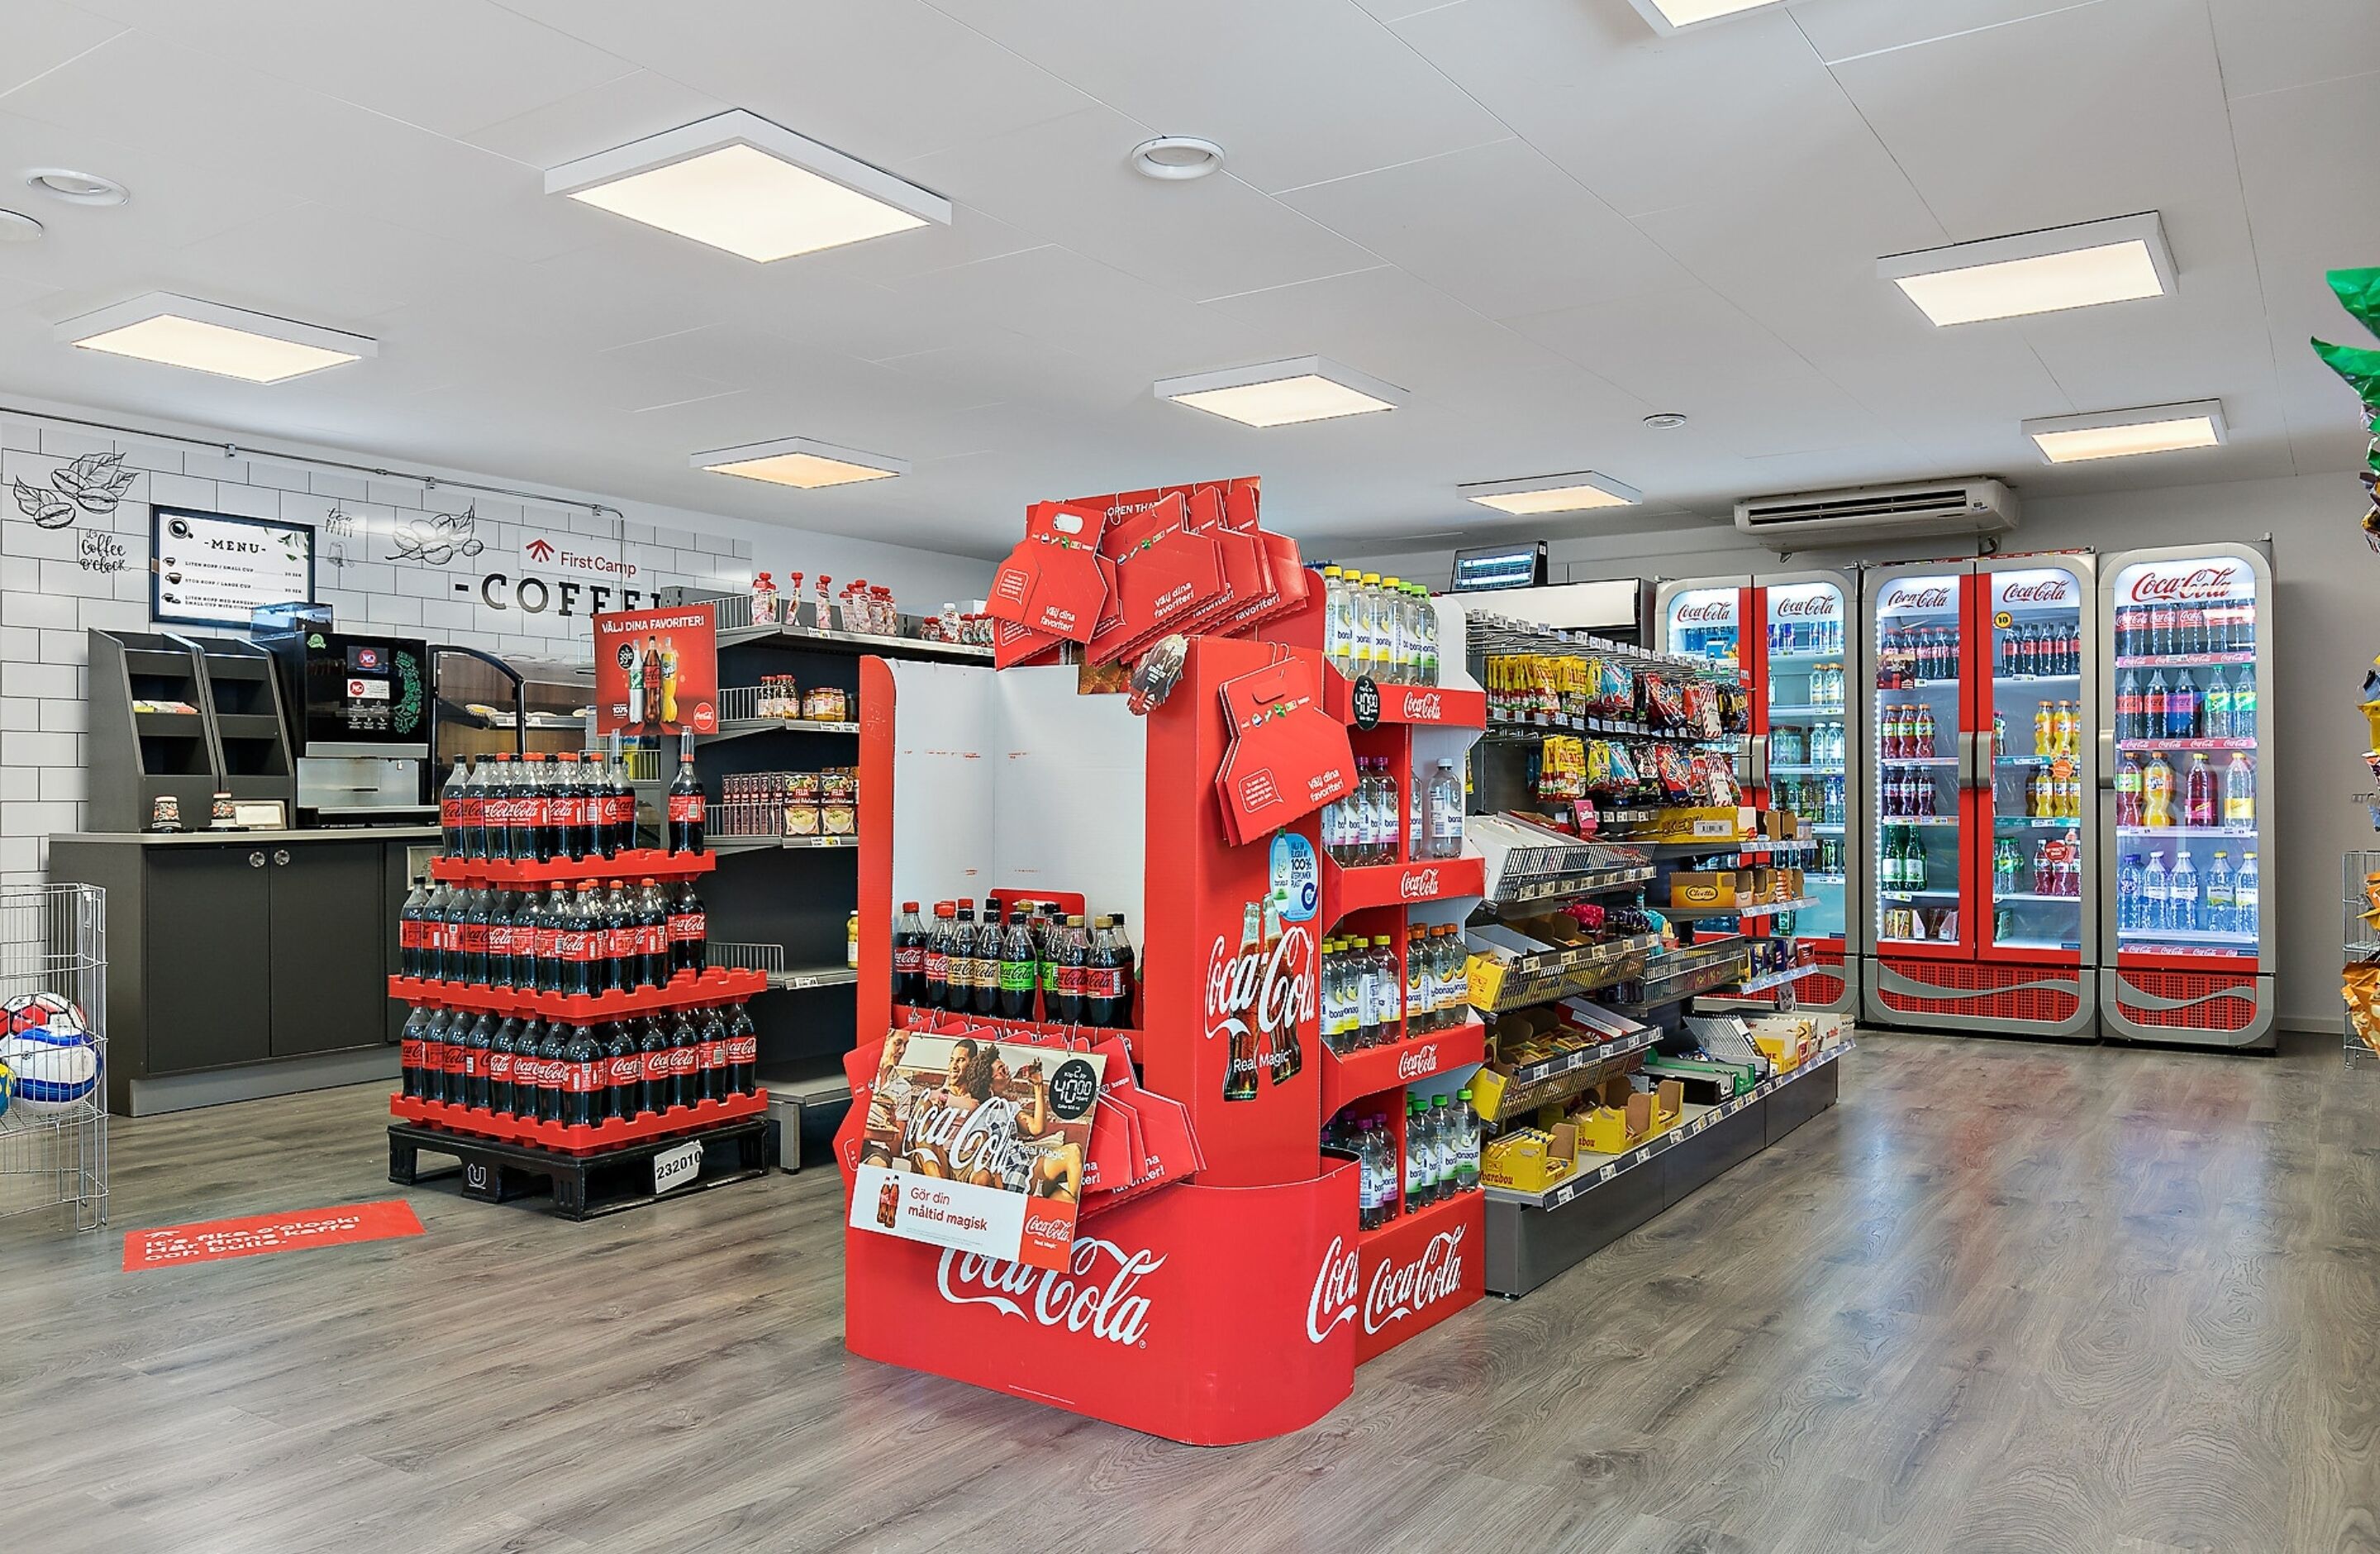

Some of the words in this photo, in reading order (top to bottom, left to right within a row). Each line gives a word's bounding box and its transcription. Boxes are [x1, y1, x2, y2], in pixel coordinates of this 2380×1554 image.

[1107, 504, 1134, 517] OPEN
[81, 533, 126, 557] Coffee
[561, 551, 592, 569] First
[594, 555, 637, 578] Camp
[1172, 581, 1192, 596] dina
[2002, 579, 2070, 603] Coca-Cola
[2131, 567, 2237, 603] Coca-Cola
[1154, 589, 1195, 619] favoriter!
[1778, 595, 1836, 617] Coca-Cola
[1887, 587, 1951, 609] Coca-Cola
[1678, 602, 1733, 623] Coca-Cola
[1404, 691, 1441, 719] Coca-Cola
[1323, 769, 1340, 782] dina
[1310, 779, 1345, 803] favoriter!
[1290, 857, 1312, 871] 100%
[1402, 868, 1440, 899] Coca-Cola
[1204, 925, 1316, 1040] Coca-Cola
[1233, 1055, 1258, 1074] Real
[1259, 1049, 1290, 1068] Magic
[1399, 1043, 1438, 1080] Coca-Cola
[1018, 1143, 1038, 1156] Real
[1039, 1146, 1069, 1161] Magic
[656, 1150, 701, 1180] 232010
[910, 1186, 931, 1202] Gör
[932, 1190, 950, 1206] din
[907, 1204, 945, 1222] måltid
[945, 1213, 988, 1232] magisk
[1025, 1214, 1073, 1242] Coca-Cola
[1363, 1223, 1468, 1335] Coca-Cola
